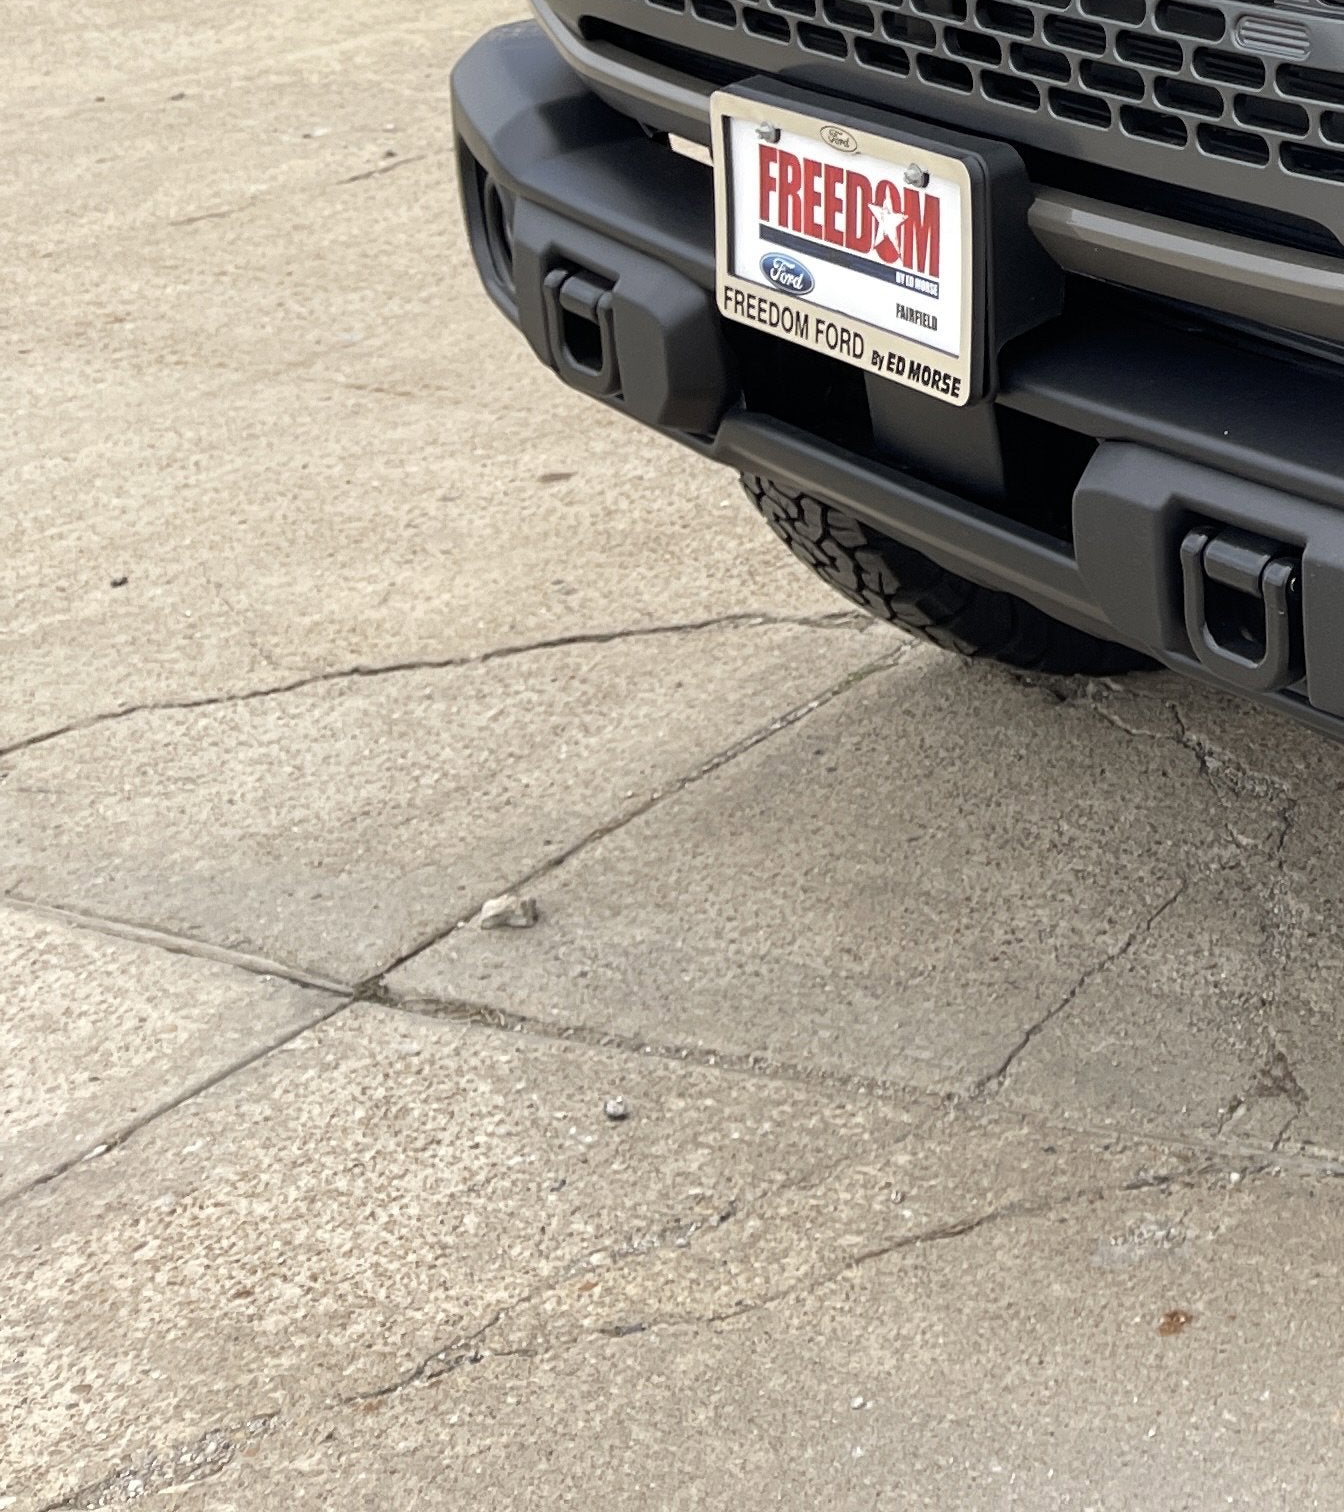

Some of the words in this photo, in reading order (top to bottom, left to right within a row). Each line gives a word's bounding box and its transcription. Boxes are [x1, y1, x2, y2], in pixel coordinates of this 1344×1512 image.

[828, 128, 850, 148] Ford
[759, 144, 940, 278] FREEDOM
[769, 259, 804, 291] Ford
[896, 303, 937, 331] FAIRFIELD
[724, 286, 809, 340] FREEDOM
[815, 318, 864, 360] FORD
[871, 349, 884, 372] By
[886, 353, 906, 377] ED
[908, 360, 961, 398] MORSE
